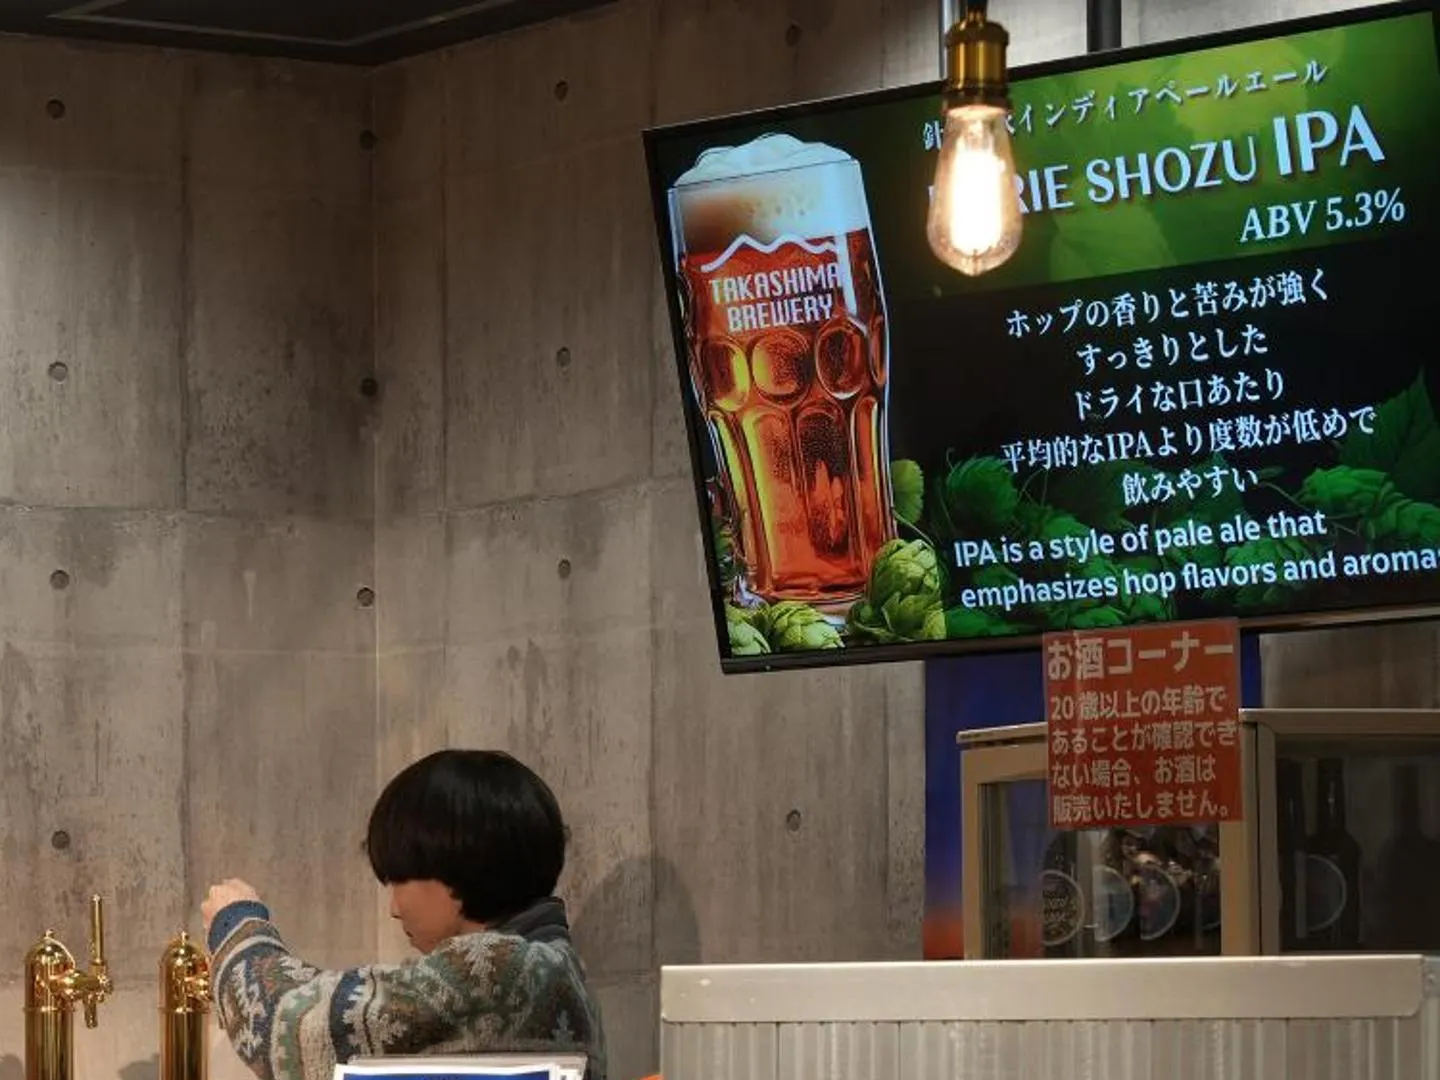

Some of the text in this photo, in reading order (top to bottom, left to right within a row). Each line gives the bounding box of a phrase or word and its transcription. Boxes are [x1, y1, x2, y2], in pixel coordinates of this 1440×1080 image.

[1085, 135, 1257, 204] SHOZU
[1272, 104, 1386, 177] IPA
[1239, 186, 1406, 244] ABV 5.3%
[709, 261, 841, 303] TAKASHIMA
[1006, 267, 1329, 340] ホップの香りと苦みが強く
[727, 293, 834, 334] BREWERY
[1077, 323, 1269, 376] すっきりとした
[1075, 368, 1285, 422] ドライな口あたり
[1000, 405, 1378, 474] 平均的なIPAより度数が低めで
[1122, 465, 1259, 507] 飲みやすい
[954, 508, 1327, 568] IPA is a style of pale ale that
[962, 547, 1440, 614] emphasizes hop flavors and aroma
[1047, 630, 1234, 681] お酒コーナー
[1051, 685, 1227, 721] 20歳以上の年齢で
[1051, 719, 1238, 755] あることが確認でき
[1051, 754, 1217, 788] ない場合、お酒は
[1053, 791, 1229, 824] 販売いたしません。
